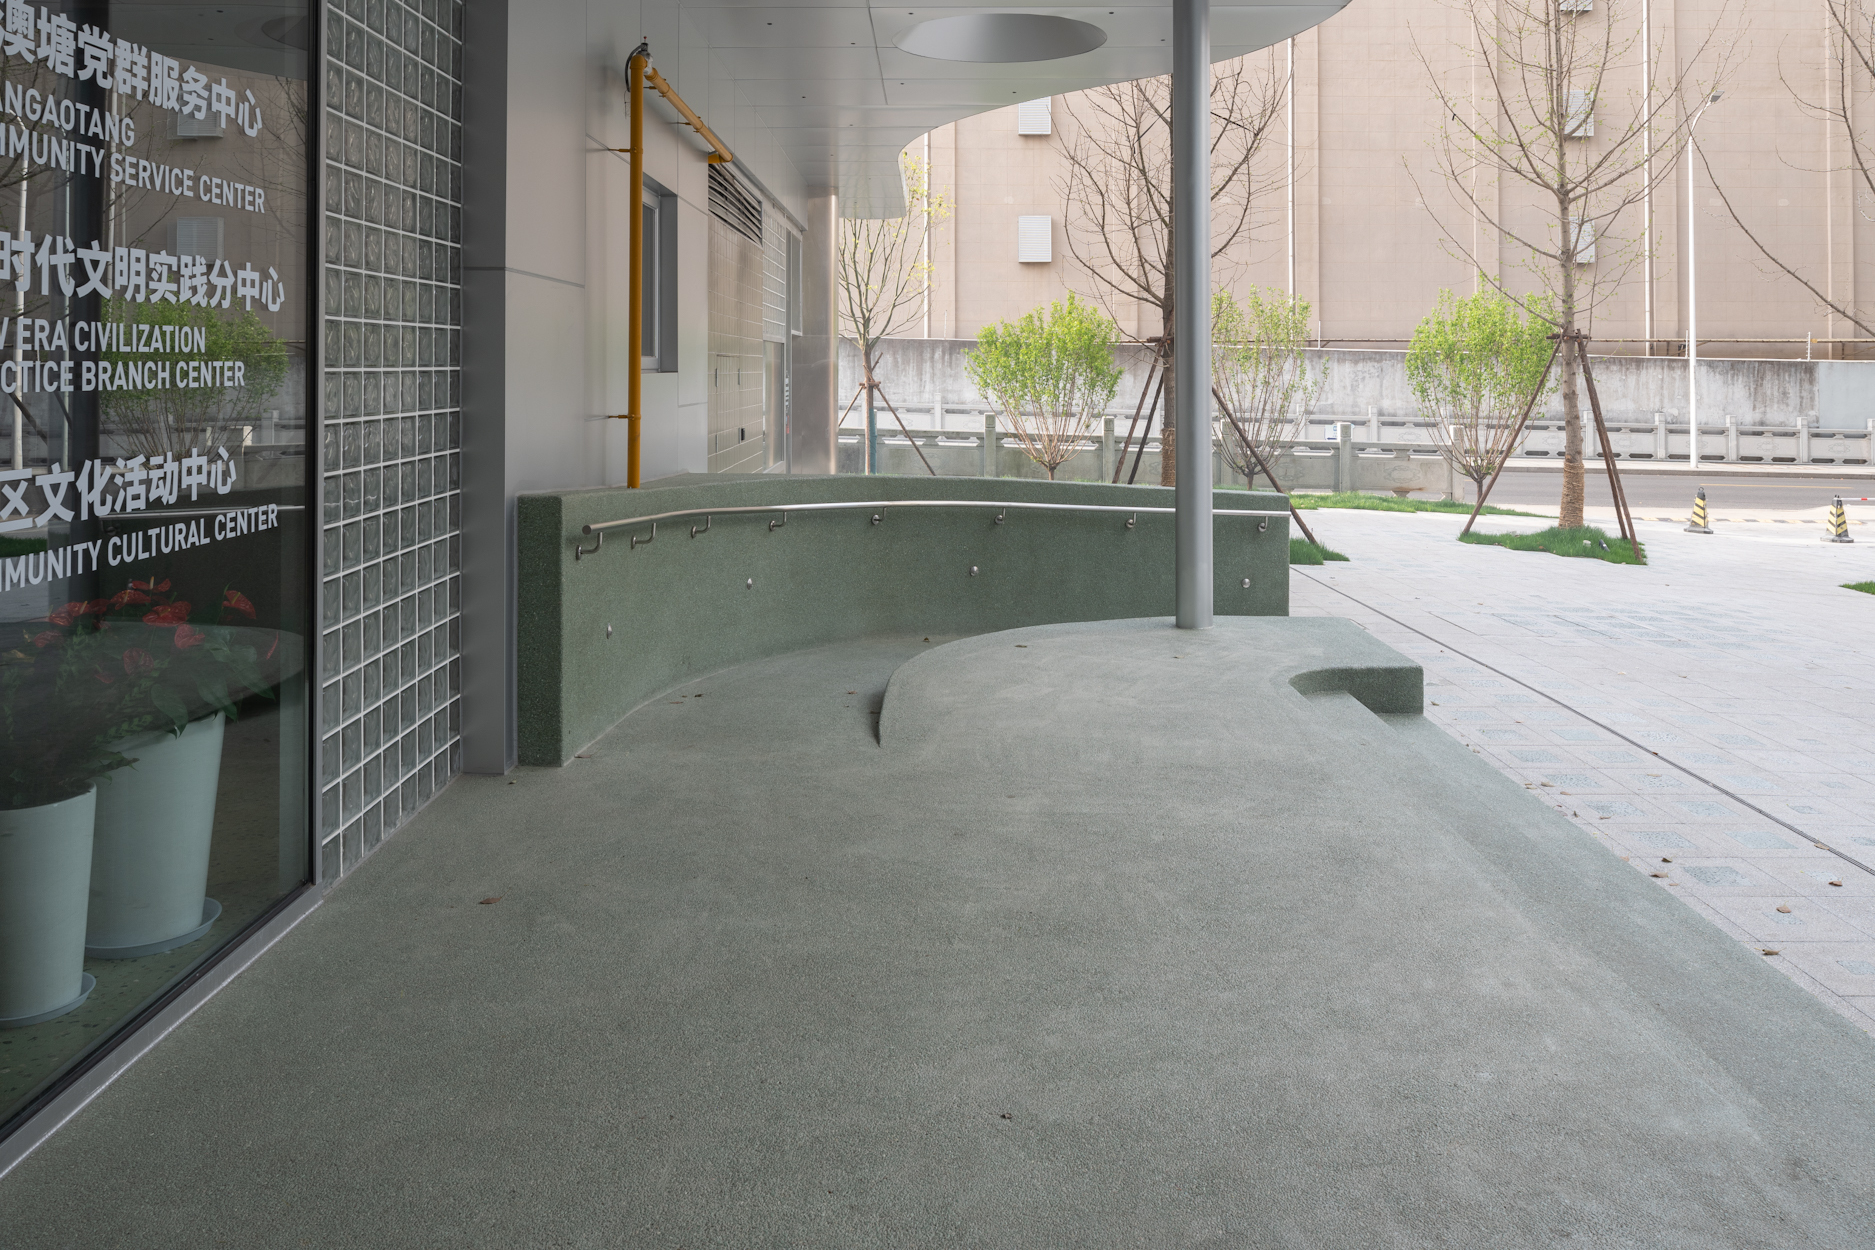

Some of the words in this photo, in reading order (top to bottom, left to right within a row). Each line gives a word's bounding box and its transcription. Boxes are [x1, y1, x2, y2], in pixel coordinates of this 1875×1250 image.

[0, 80, 135, 147] NGAOTANG
[0, 122, 104, 178] MUNITY
[110, 152, 194, 197] SERVICE
[200, 175, 265, 213] CENTER
[0, 230, 285, 312] 时代文明实践分中心
[17, 318, 68, 351] ERA
[74, 321, 206, 353] CIVILIZATION
[0, 360, 74, 393] CTICE
[82, 361, 170, 391] BRANCH
[176, 361, 245, 388] CENTER
[0, 539, 102, 592] MUNITY
[108, 518, 210, 567] CULTURAL
[214, 503, 278, 541] CENTER
